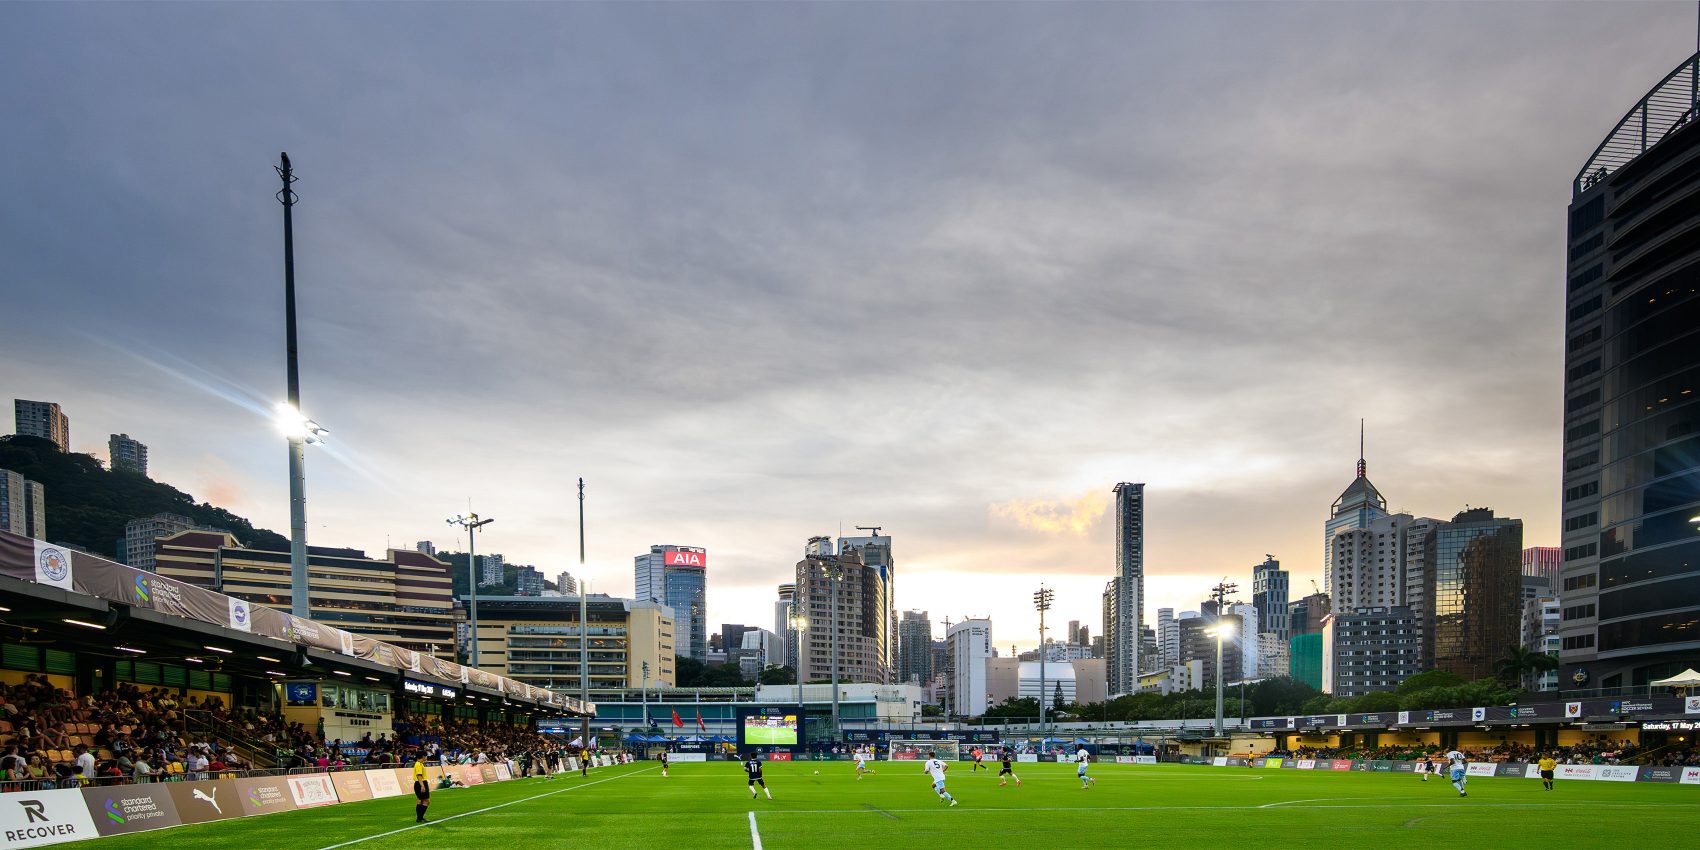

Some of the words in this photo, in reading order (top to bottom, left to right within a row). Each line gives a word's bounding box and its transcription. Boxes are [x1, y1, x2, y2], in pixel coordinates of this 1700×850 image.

[674, 554, 700, 566] AIA
[1680, 722, 1694, 731] May
[751, 764, 757, 772] 11
[933, 761, 940, 769] 5
[121, 796, 152, 806] standard
[124, 803, 156, 813] chartered
[6, 824, 76, 842] RECOVER
